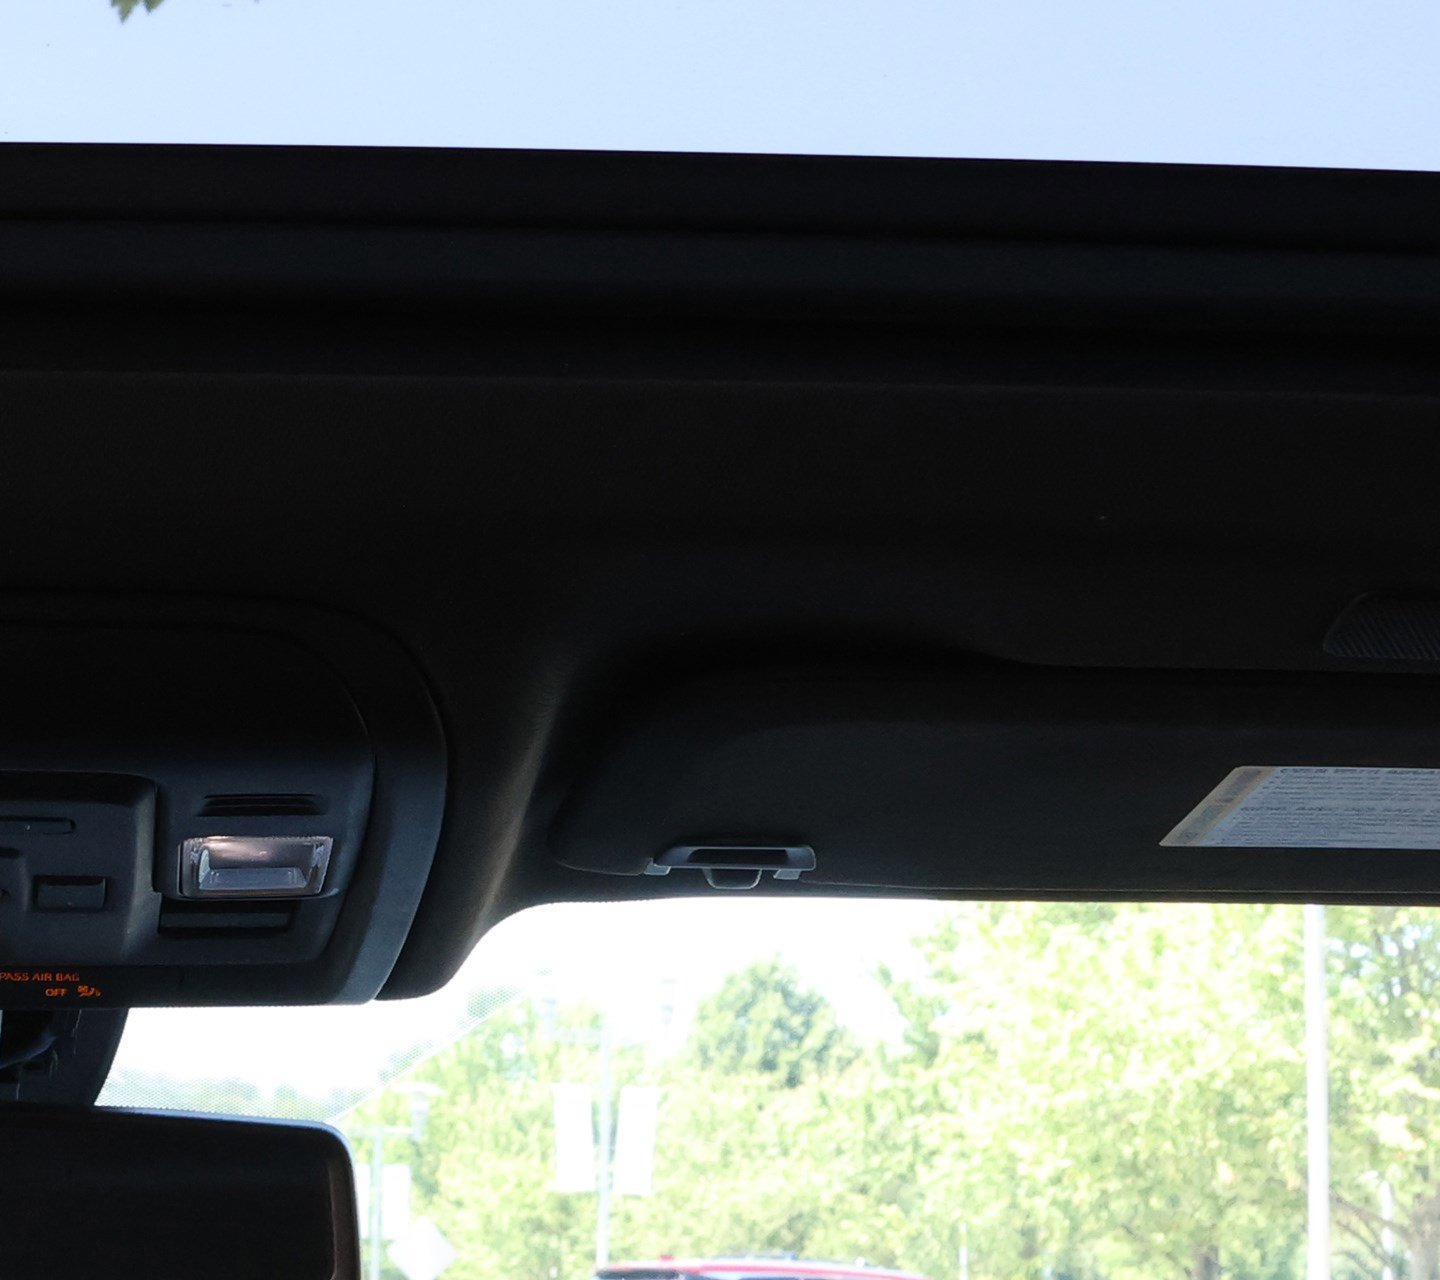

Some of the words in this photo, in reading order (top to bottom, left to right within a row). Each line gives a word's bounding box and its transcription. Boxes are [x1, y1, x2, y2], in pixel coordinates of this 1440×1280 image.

[0, 971, 29, 982] PASS
[32, 972, 53, 982] AIR
[56, 972, 81, 983] BAG
[45, 987, 68, 998] OFF
